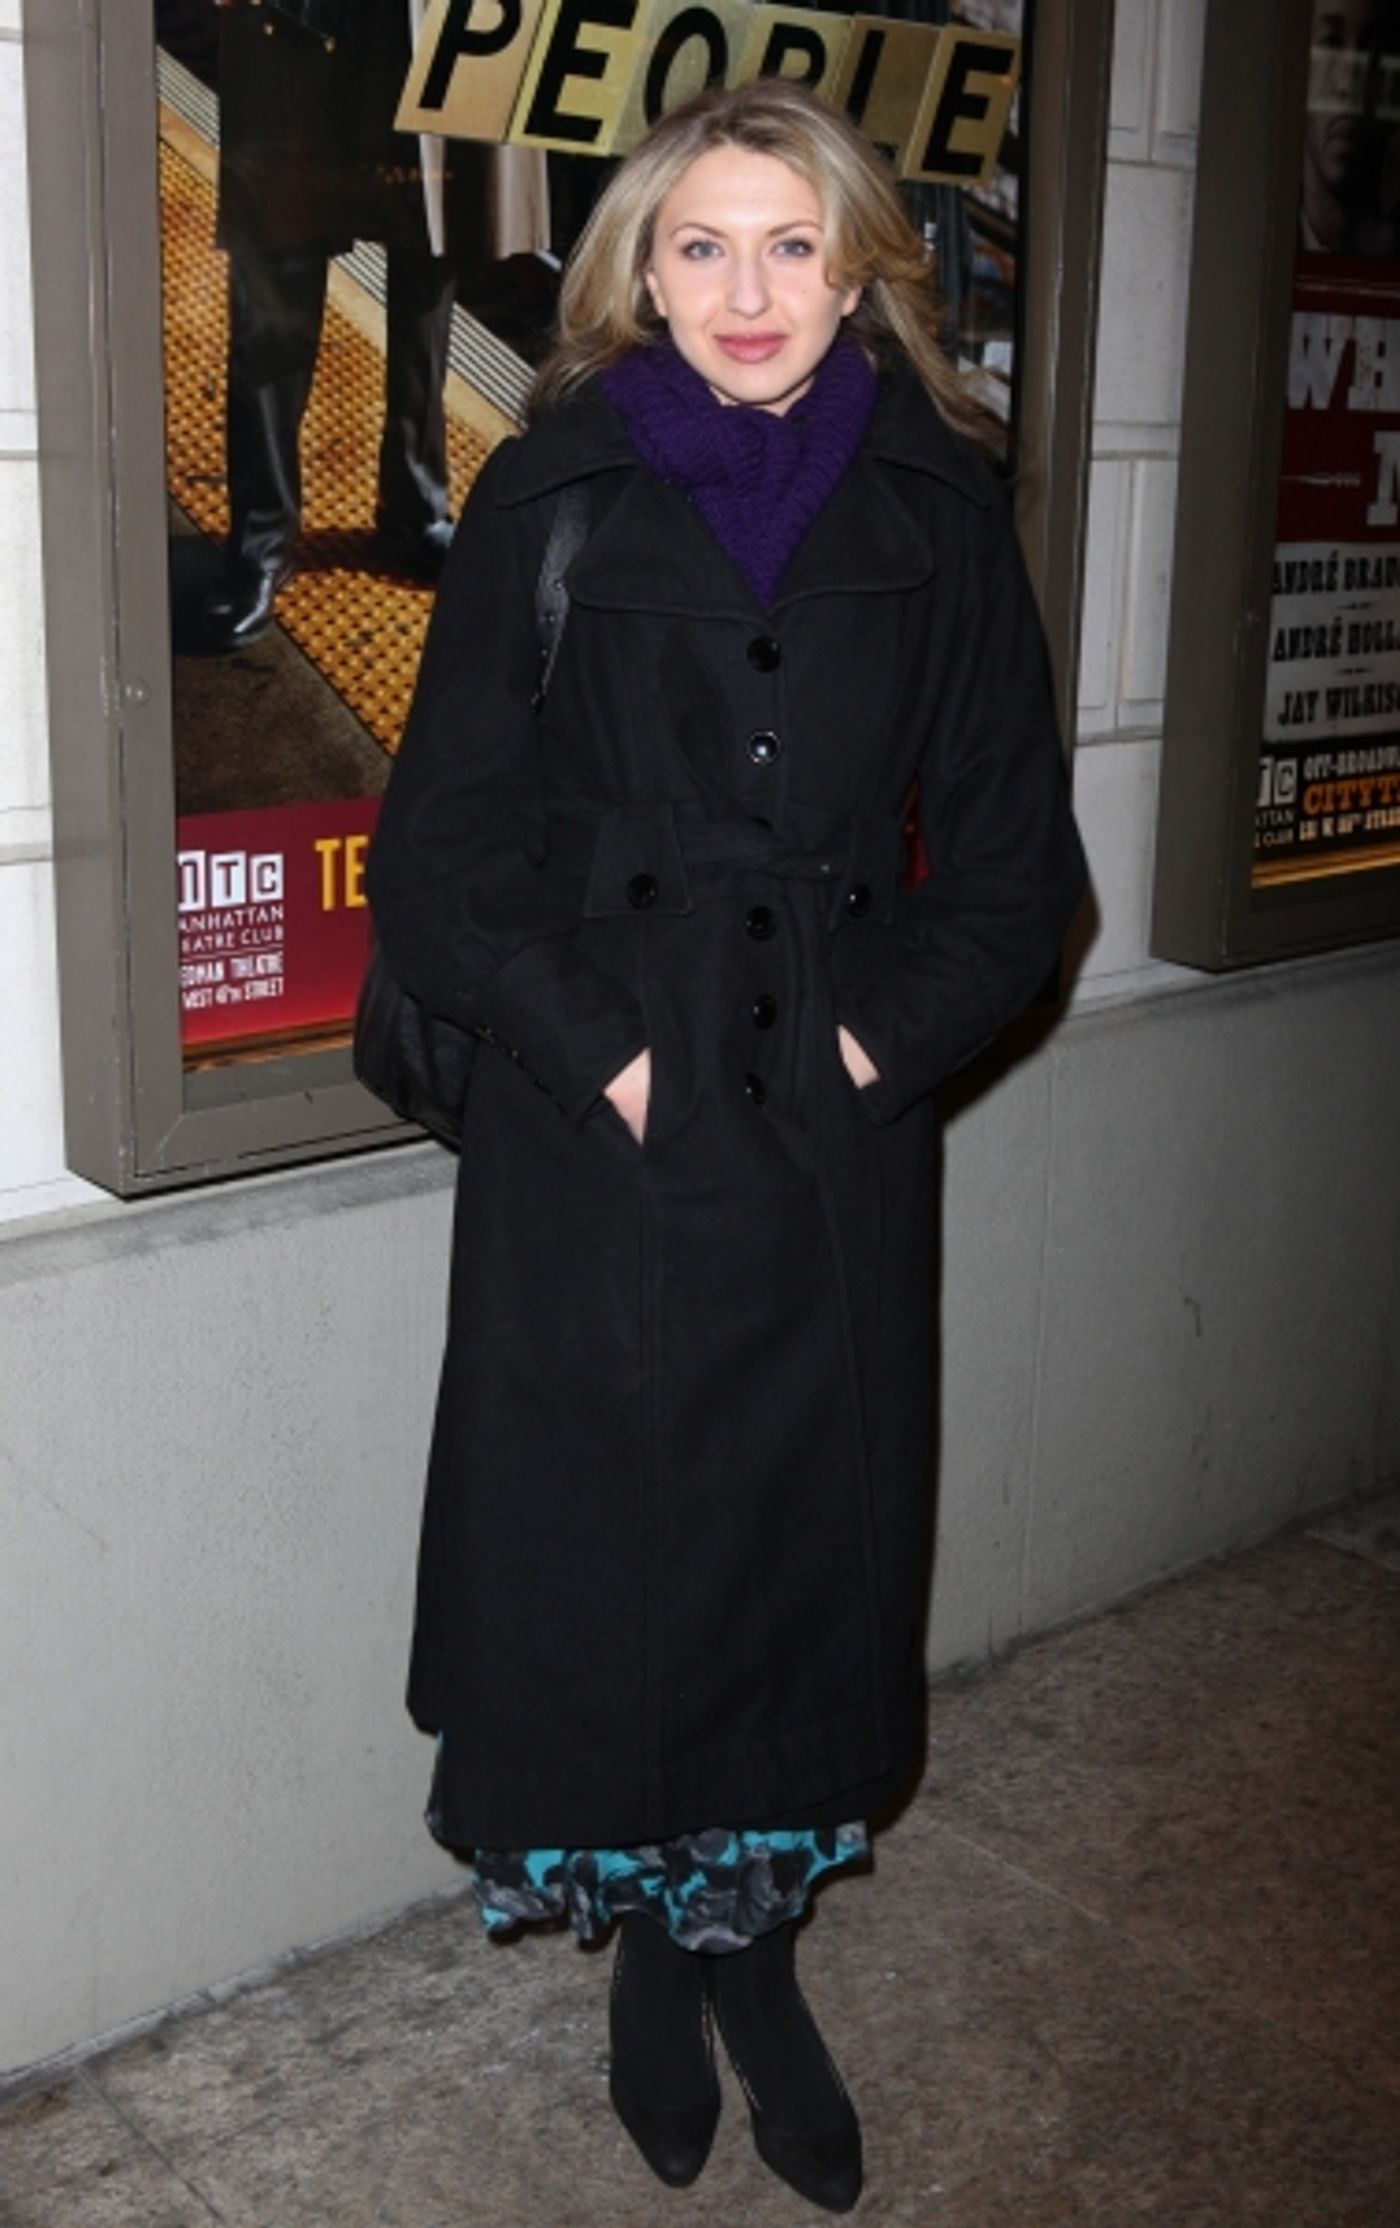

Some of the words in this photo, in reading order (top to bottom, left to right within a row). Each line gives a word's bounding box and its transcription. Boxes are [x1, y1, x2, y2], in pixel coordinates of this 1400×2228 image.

[1277, 690, 1319, 726] JAY
[1326, 682, 1400, 720] WILKIS
[1303, 771, 1400, 815] CITYT
[315, 835, 369, 911] TE
[241, 924, 284, 945] CLUB
